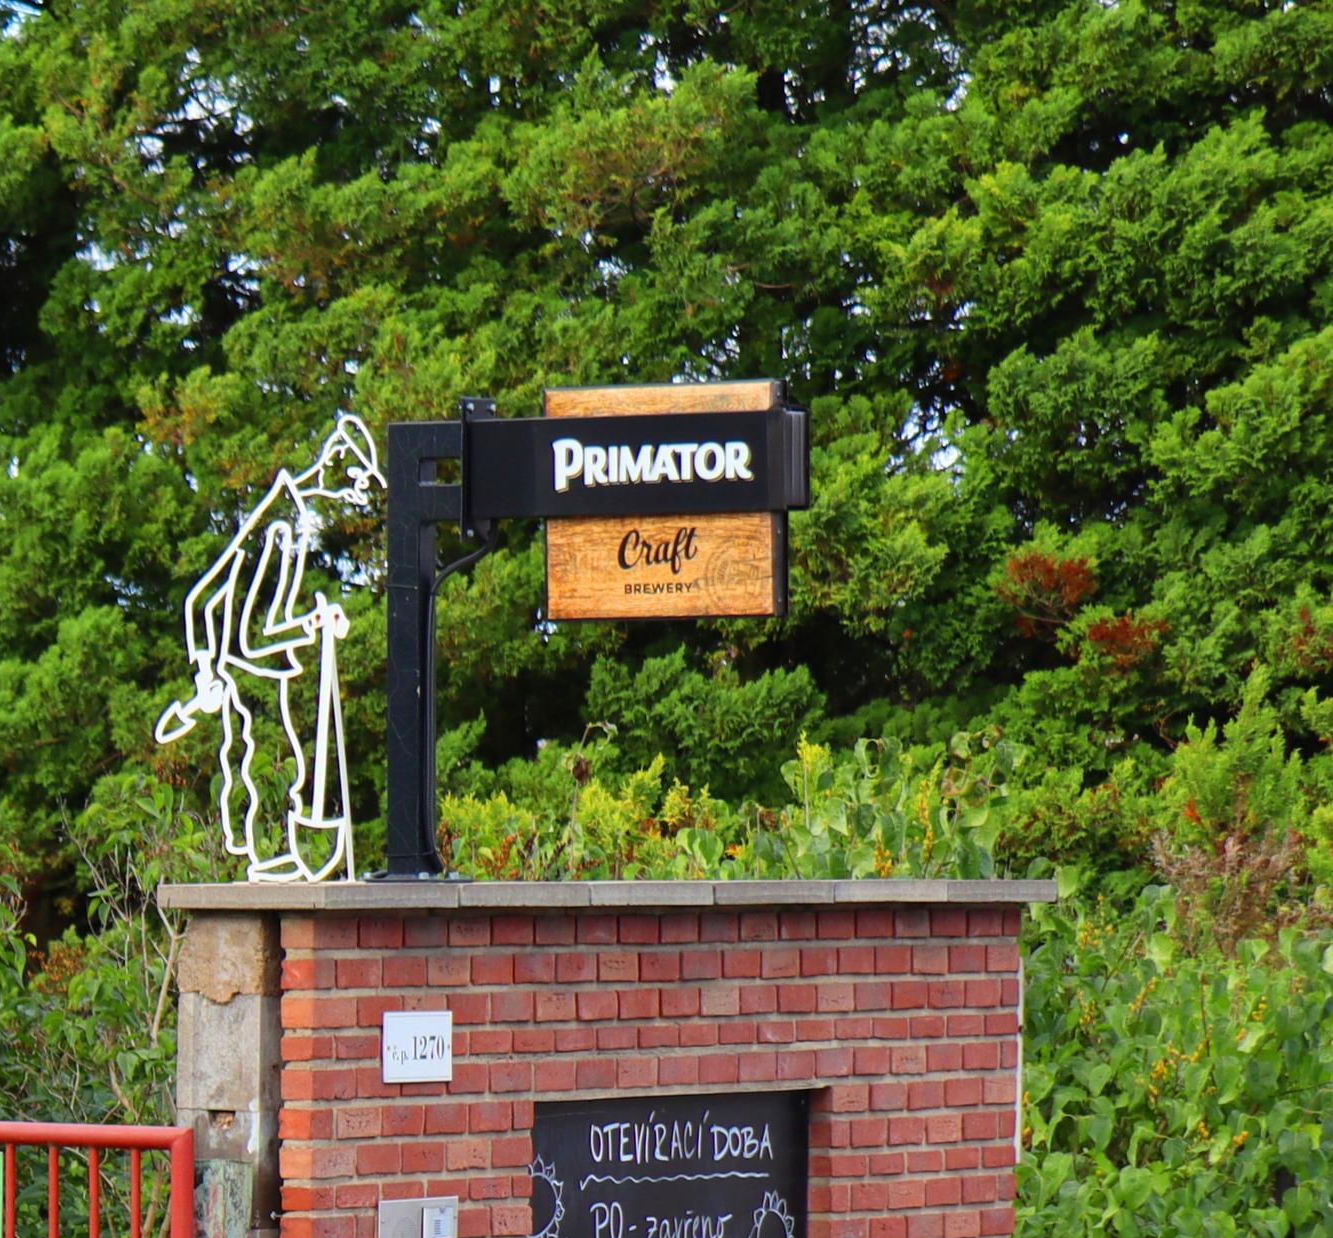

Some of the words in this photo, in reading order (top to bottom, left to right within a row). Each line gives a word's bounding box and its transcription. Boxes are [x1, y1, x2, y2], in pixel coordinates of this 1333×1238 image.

[552, 438, 754, 493] PRIMATOR
[618, 527, 698, 574] Craft
[624, 582, 694, 595] BREWERY
[413, 1035, 445, 1060] 1270
[590, 1110, 710, 1165] OTEVÍRACÍ
[710, 1123, 773, 1161] DOBA
